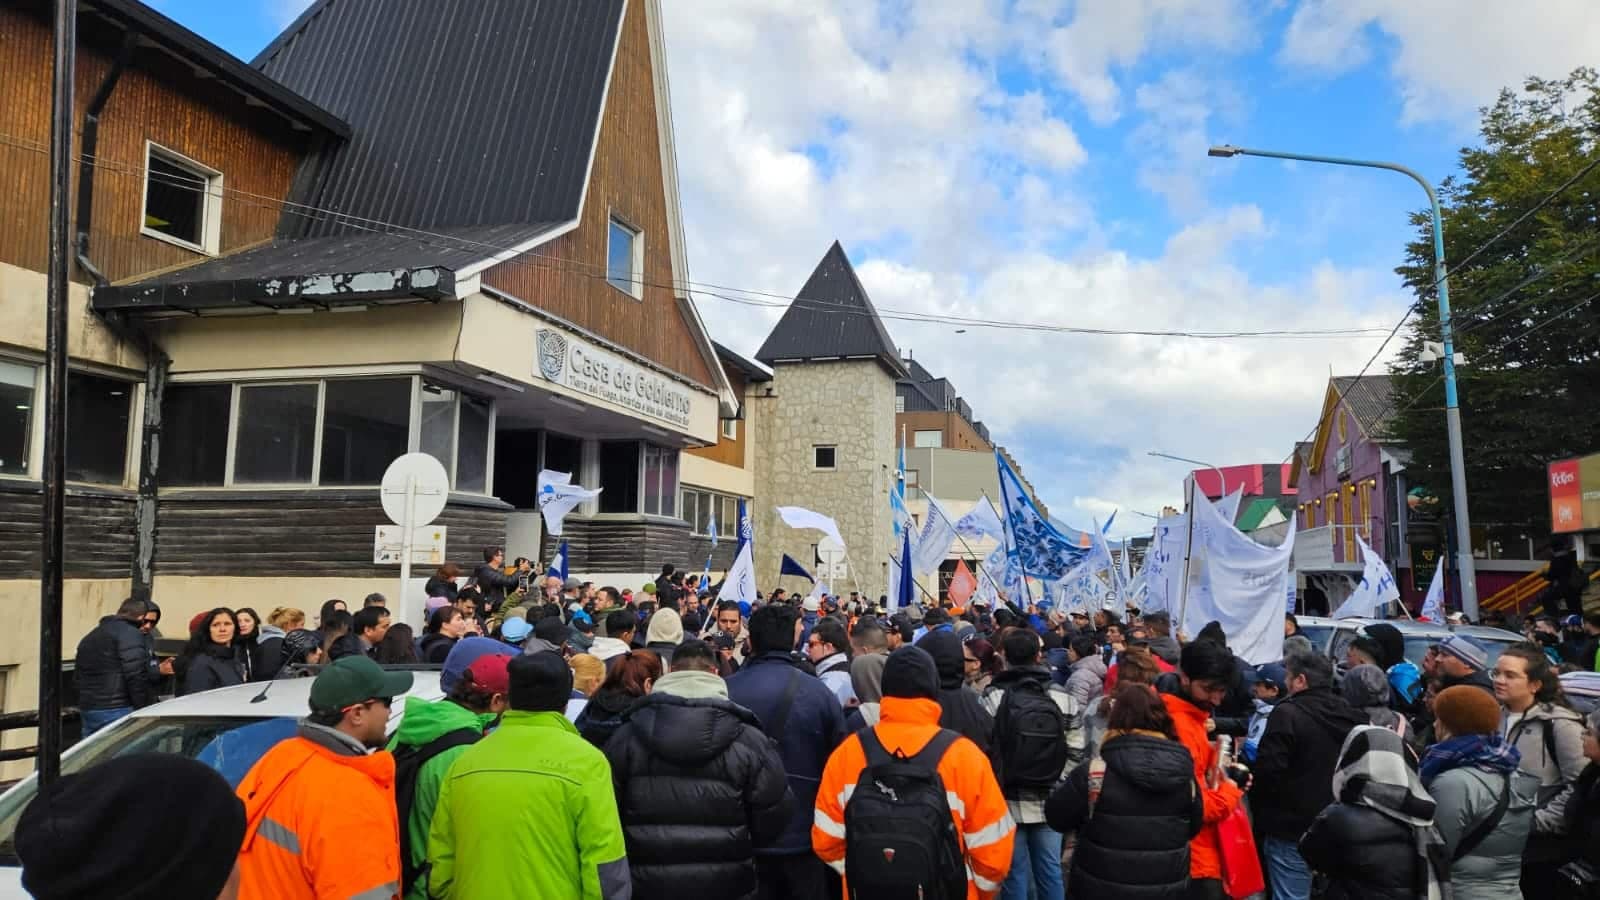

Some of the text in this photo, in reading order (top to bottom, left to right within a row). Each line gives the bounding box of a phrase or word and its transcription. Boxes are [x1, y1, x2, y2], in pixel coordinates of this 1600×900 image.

[570, 345, 609, 384] Casa
[613, 364, 632, 391] de
[635, 372, 691, 415] Gobierno
